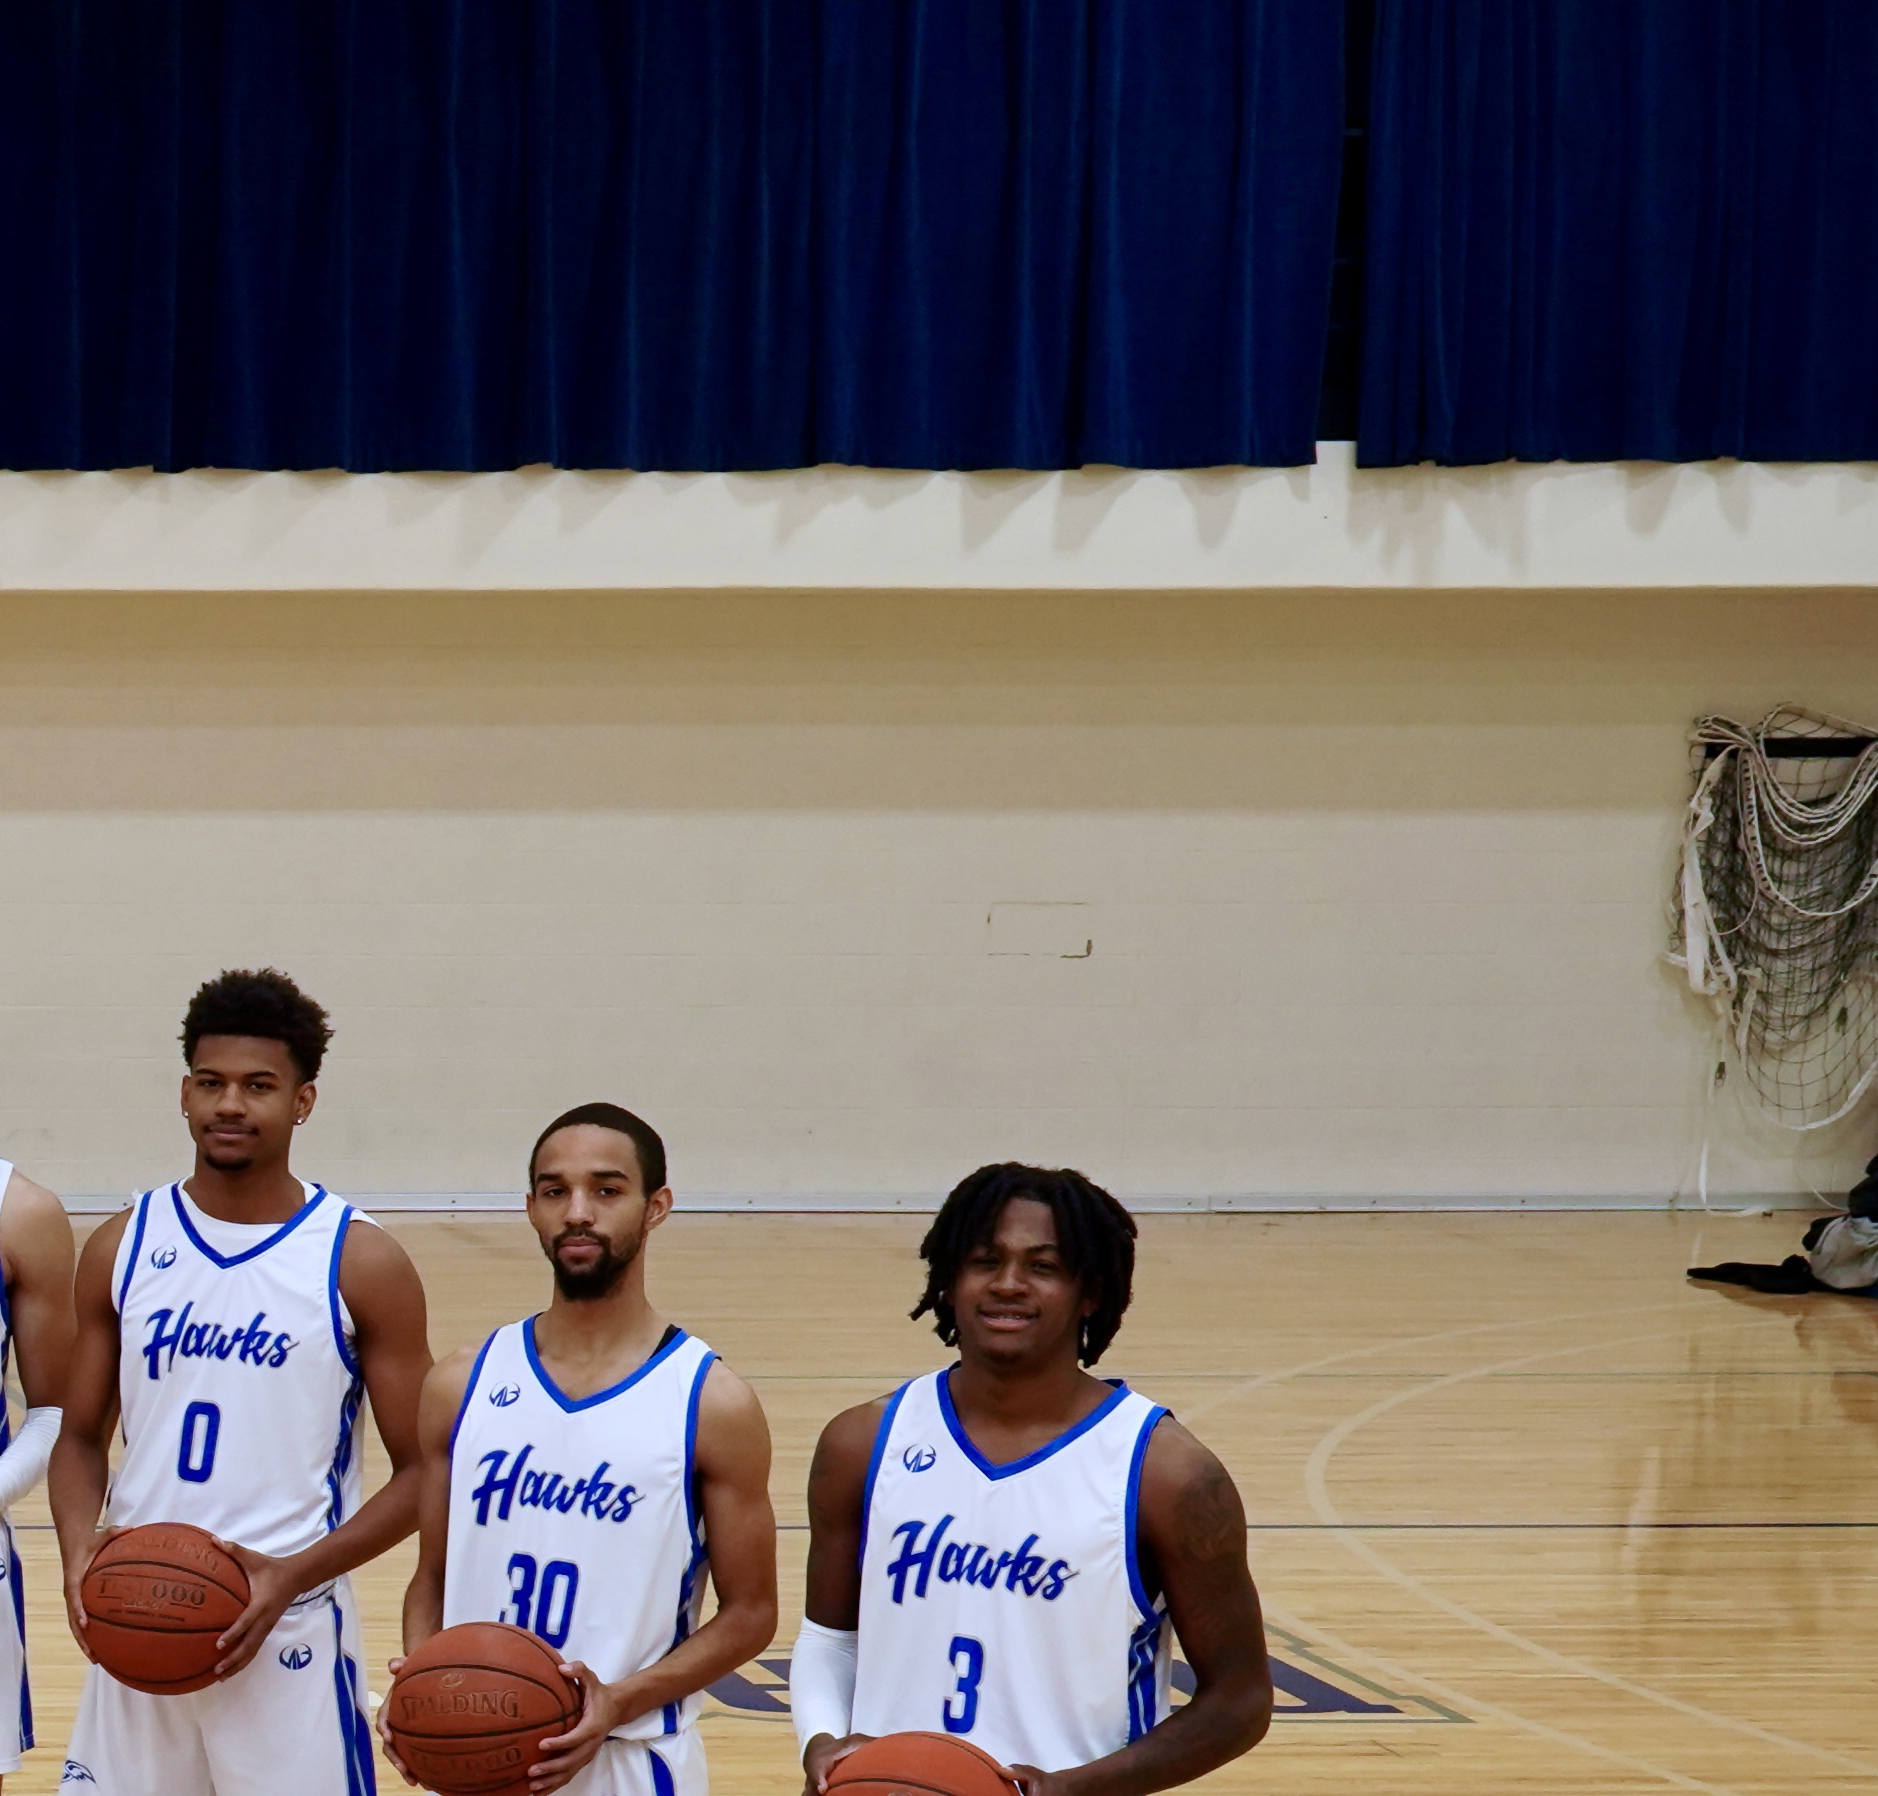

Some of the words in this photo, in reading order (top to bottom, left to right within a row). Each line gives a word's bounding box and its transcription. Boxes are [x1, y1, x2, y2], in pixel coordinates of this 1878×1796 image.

[142, 1301, 297, 1381] Hawks
[176, 1400, 222, 1485] 0
[471, 1444, 644, 1527] Hawks
[499, 1551, 580, 1650] 30
[886, 1514, 1078, 1605] Hawks
[401, 1691, 519, 1721] SPALDING
[941, 1634, 985, 1735] 3
